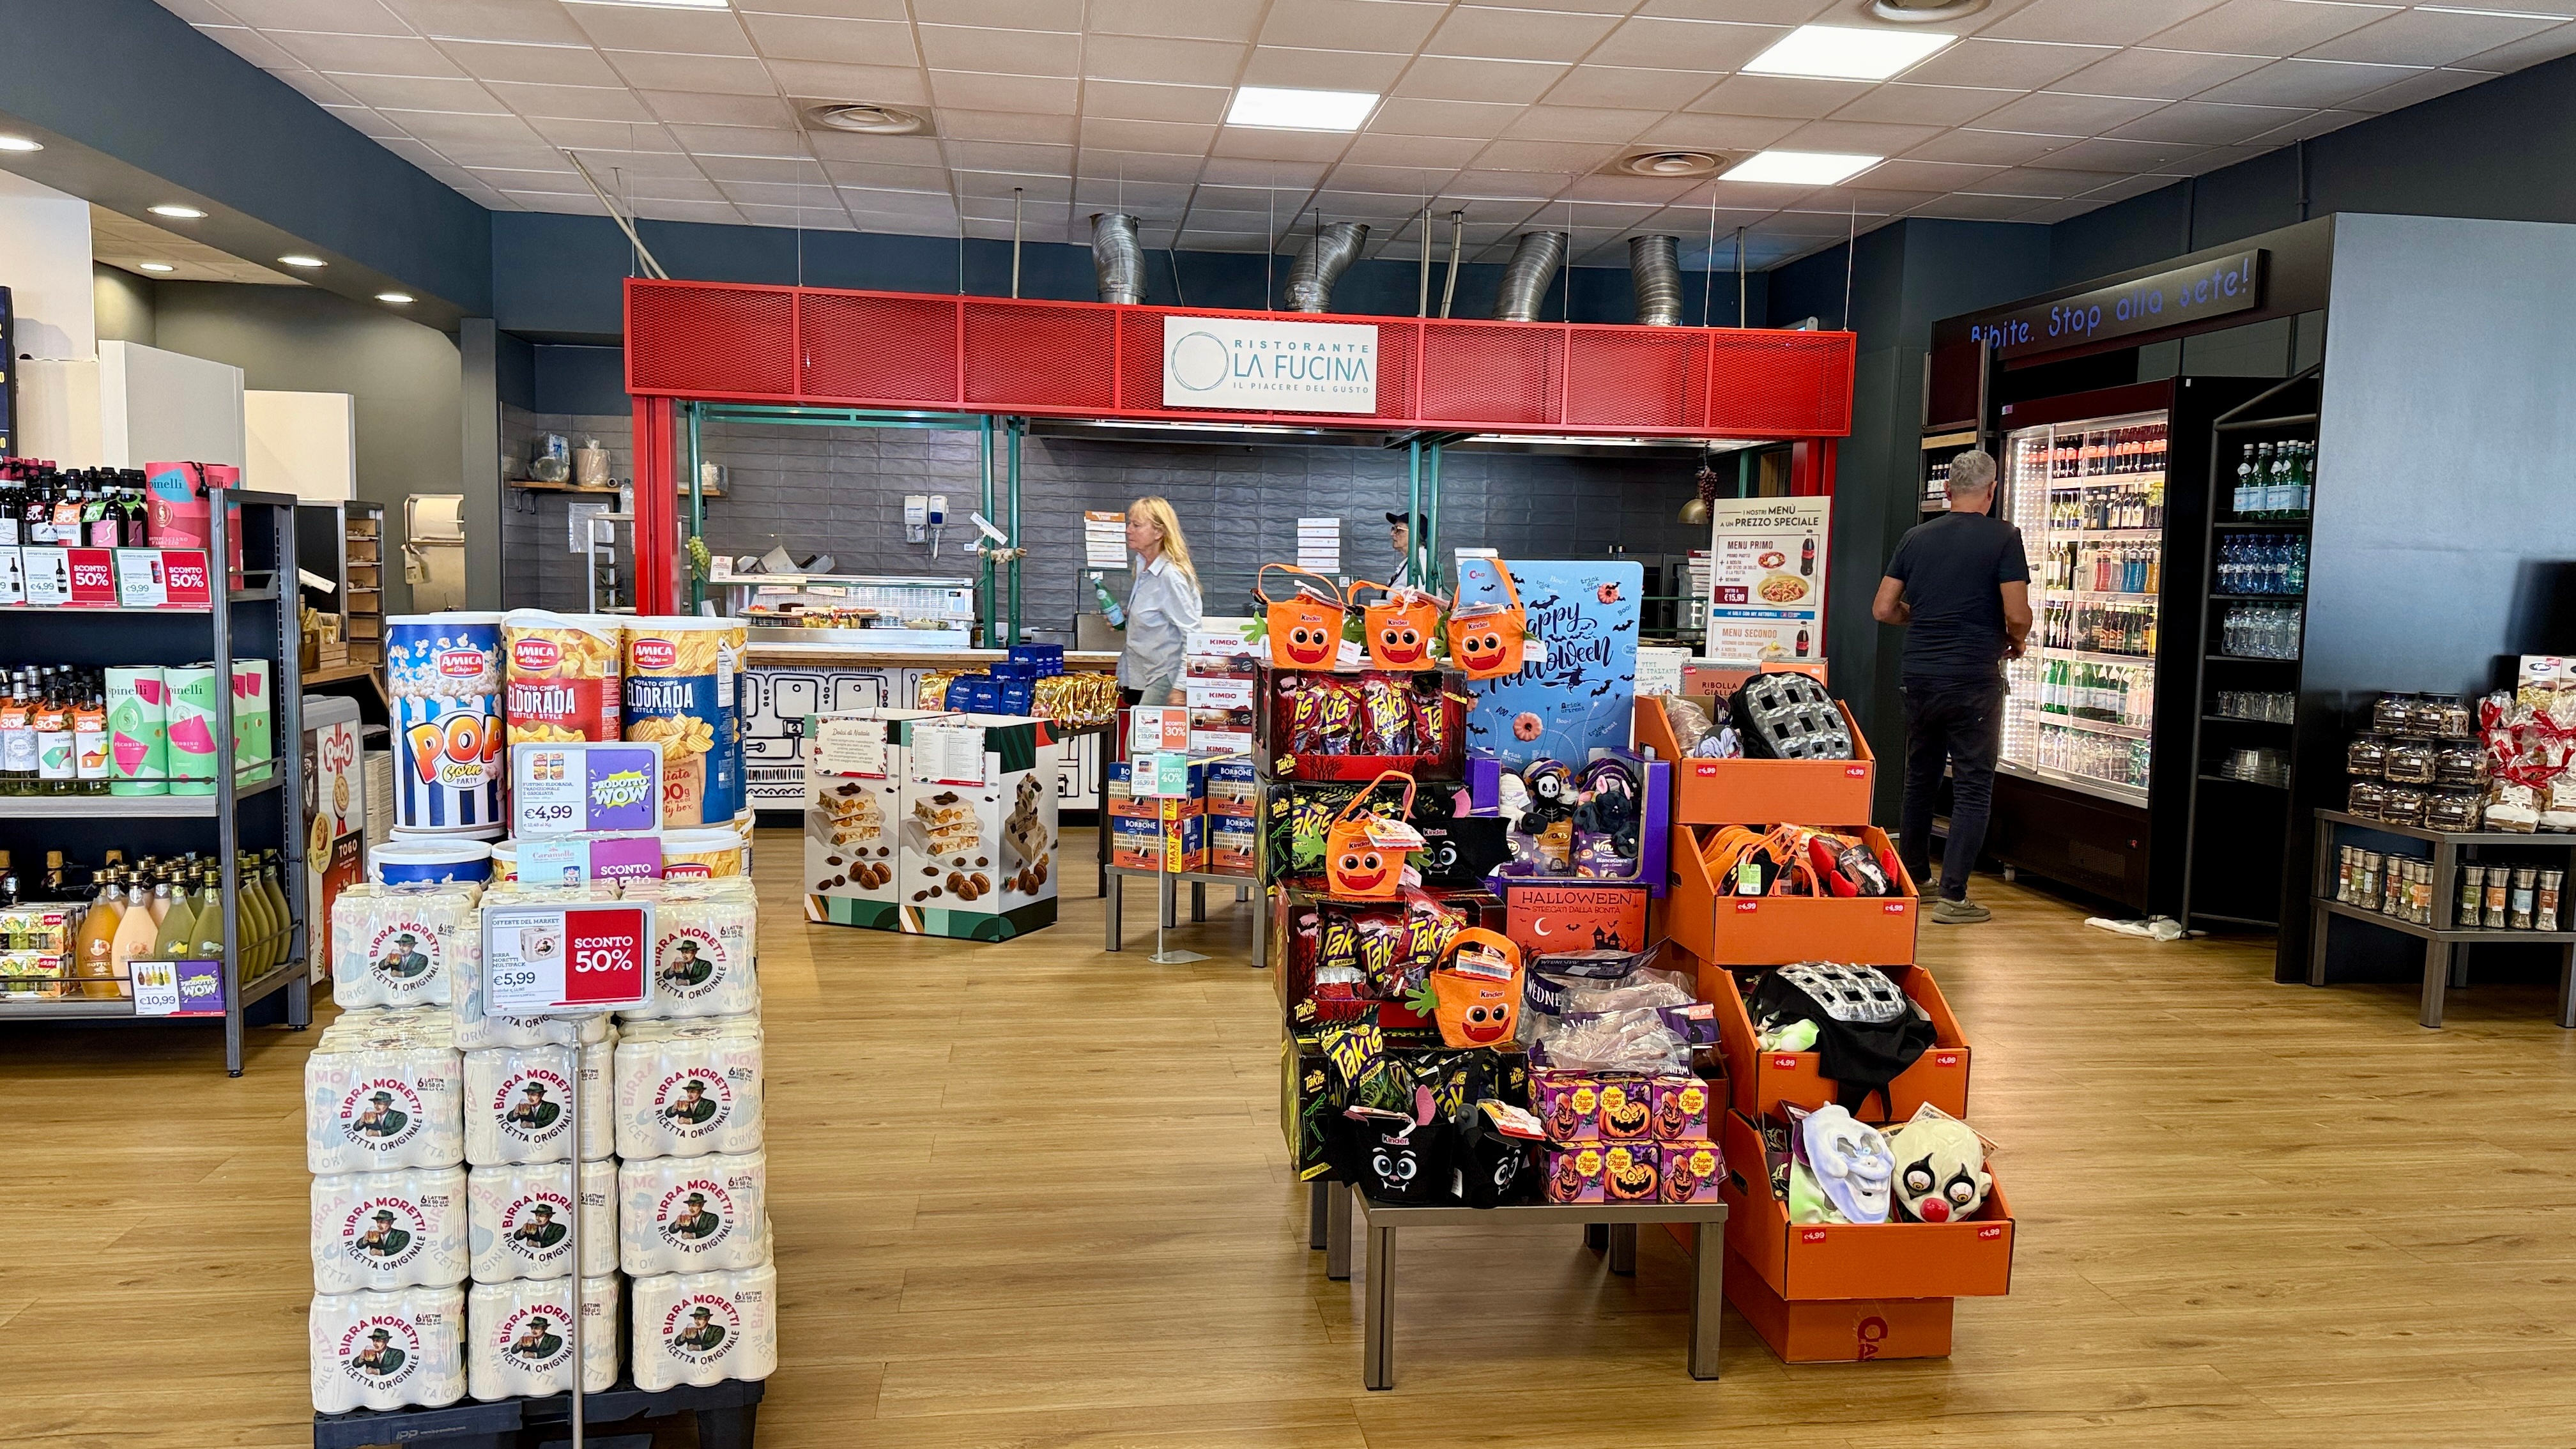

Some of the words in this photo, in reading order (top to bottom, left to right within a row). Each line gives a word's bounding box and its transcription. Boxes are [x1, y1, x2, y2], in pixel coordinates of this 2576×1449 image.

[2048, 305, 2100, 337] Stop
[2117, 288, 2163, 320] alla
[1235, 340, 1368, 353] RISTORANTE
[1234, 353, 1264, 378] LA
[1275, 355, 1368, 382] FUCINA
[1251, 383, 1298, 391] PIACERE
[1768, 503, 1796, 515] MENÙ
[1735, 518, 1771, 526] PREZZO
[1774, 517, 1819, 526] SPECIALE
[1750, 540, 1773, 549] PRIMO
[75, 572, 109, 586] 50%
[171, 574, 204, 587] 50%
[126, 585, 149, 594] €9,99
[1468, 622, 1489, 630] Kinder
[1722, 629, 1742, 637] MENU
[1745, 629, 1777, 638] SECONDO
[516, 645, 555, 657] AMICA
[635, 645, 673, 656] AMICA
[441, 656, 482, 666] AMICA
[525, 656, 543, 666] Chips
[644, 656, 661, 664] Chips
[454, 664, 473, 674] Chips
[508, 685, 576, 714] ELDORADA
[627, 680, 693, 708] ELDORADA
[1165, 726, 1186, 736] 30%
[406, 714, 504, 785] POP
[1276, 756, 1296, 770] Takis
[442, 763, 483, 782] Corn
[1161, 773, 1182, 783] 40%
[1220, 767, 1252, 776] BORBONE
[591, 777, 648, 790] PRODOTTO
[593, 786, 650, 805] WOW
[524, 805, 572, 821] €4,99
[1272, 800, 1290, 815] Takis
[1126, 820, 1156, 829] BORBONE
[1226, 818, 1254, 827] BORBON
[339, 839, 358, 858] TOGO
[1349, 840, 1372, 848] Kinder
[601, 864, 651, 875] SCONTO
[1522, 892, 1632, 905] HALLOWEEN
[369, 925, 397, 958] BIRRA
[401, 923, 440, 956] MORETTI
[574, 936, 633, 948] SCONTO
[575, 949, 633, 972] 50%
[369, 962, 397, 990] RICETTA
[402, 960, 440, 991] ORIGINALE
[493, 972, 535, 987] €5,99
[181, 984, 217, 995] WOW
[1526, 973, 1561, 1007] WEDNE
[140, 996, 176, 1006] €10,99
[1294, 1002, 1318, 1016] Takis
[1331, 1027, 1383, 1089] Takis
[1305, 1073, 1326, 1091] Takis
[341, 1082, 371, 1119] BIRRA
[374, 1078, 422, 1114] MORETTI
[1602, 1099, 1621, 1107] Chups
[1574, 1101, 1593, 1110] Chups
[341, 1123, 375, 1151] RICETTA
[381, 1118, 422, 1151] ORIGINALE
[1578, 1162, 1597, 1172] Chups
[1608, 1160, 1627, 1170] Chups
[420, 1195, 427, 1204] 6
[657, 1186, 685, 1222] BIRRA
[687, 1179, 733, 1214] MORETTI
[343, 1201, 374, 1236] BIRRA
[376, 1197, 425, 1231] MORETTI
[658, 1226, 690, 1253] RICETTA
[695, 1219, 733, 1253] ORIGINALE
[344, 1241, 378, 1269] RICETTA
[383, 1236, 425, 1271] ORIGINALE
[663, 1299, 691, 1335] BIRRA
[694, 1295, 740, 1326] MORETTI
[664, 1338, 696, 1364] RICETTA
[701, 1331, 739, 1365] ORIGINALE
